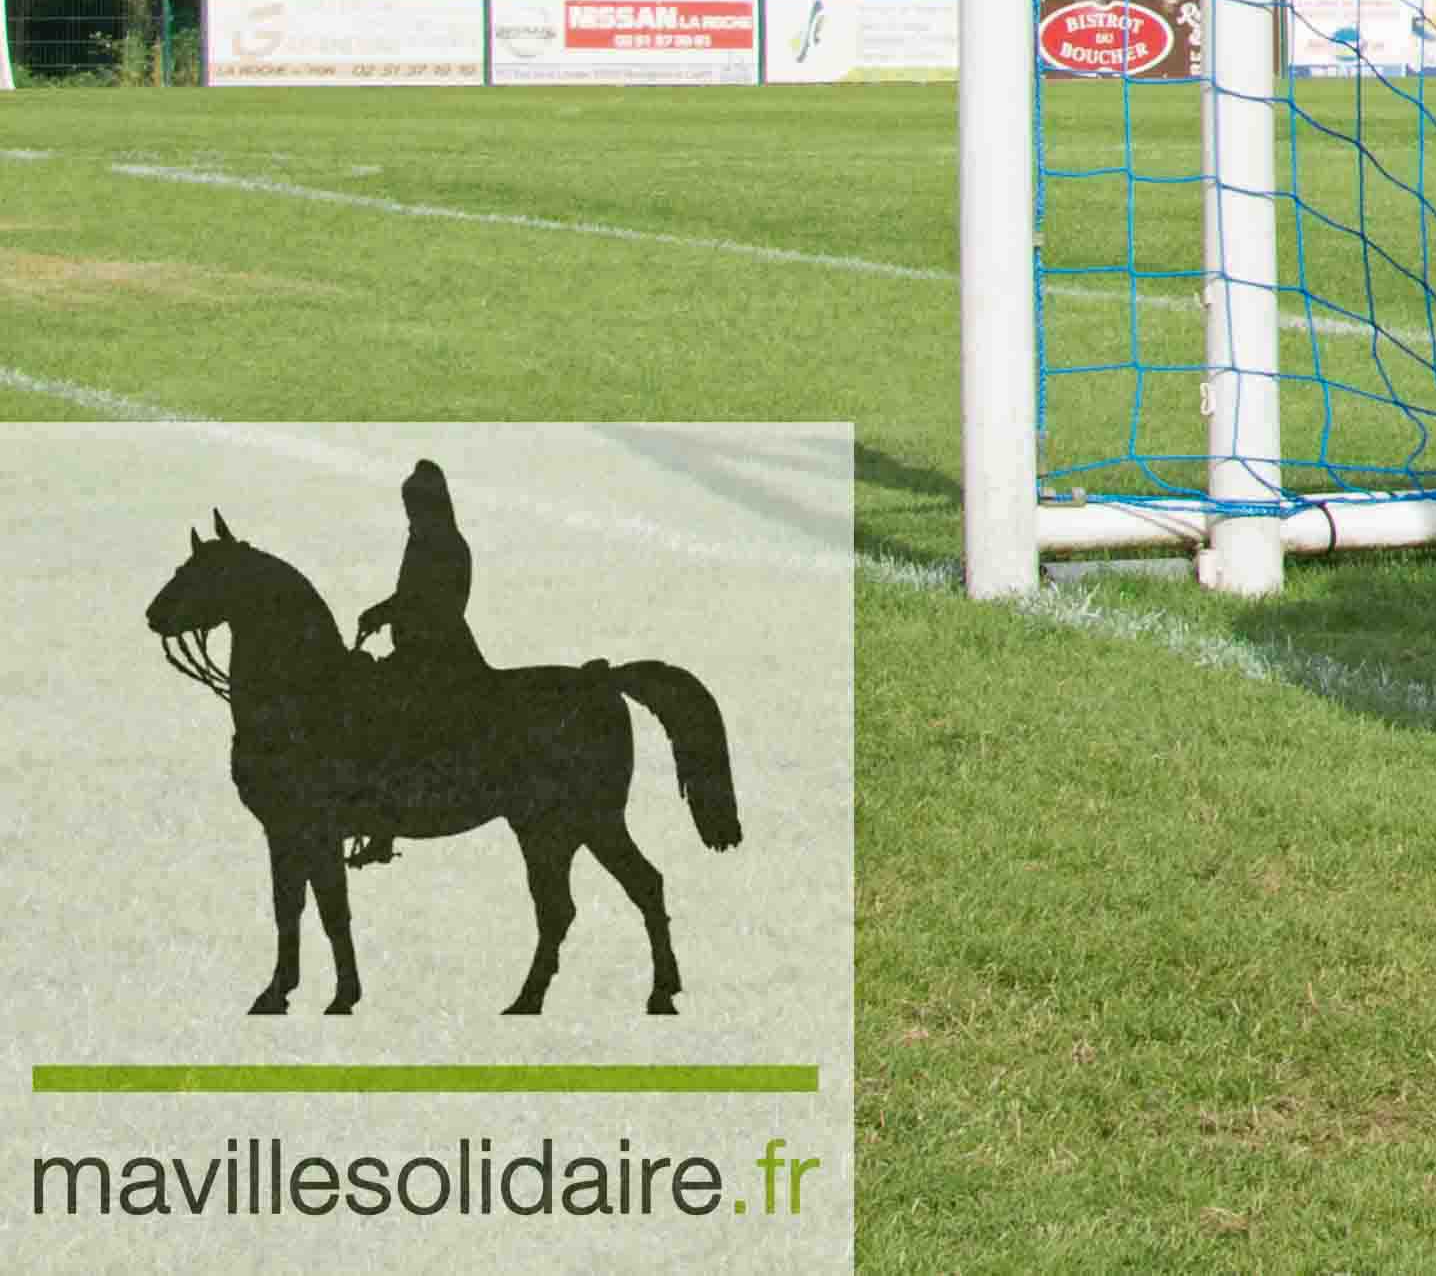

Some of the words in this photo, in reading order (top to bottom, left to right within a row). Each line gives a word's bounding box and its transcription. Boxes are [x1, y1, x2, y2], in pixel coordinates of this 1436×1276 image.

[569, 5, 678, 30] NISSAN
[1064, 12, 1145, 35] BISTROT
[1060, 42, 1149, 64] BOUCHER
